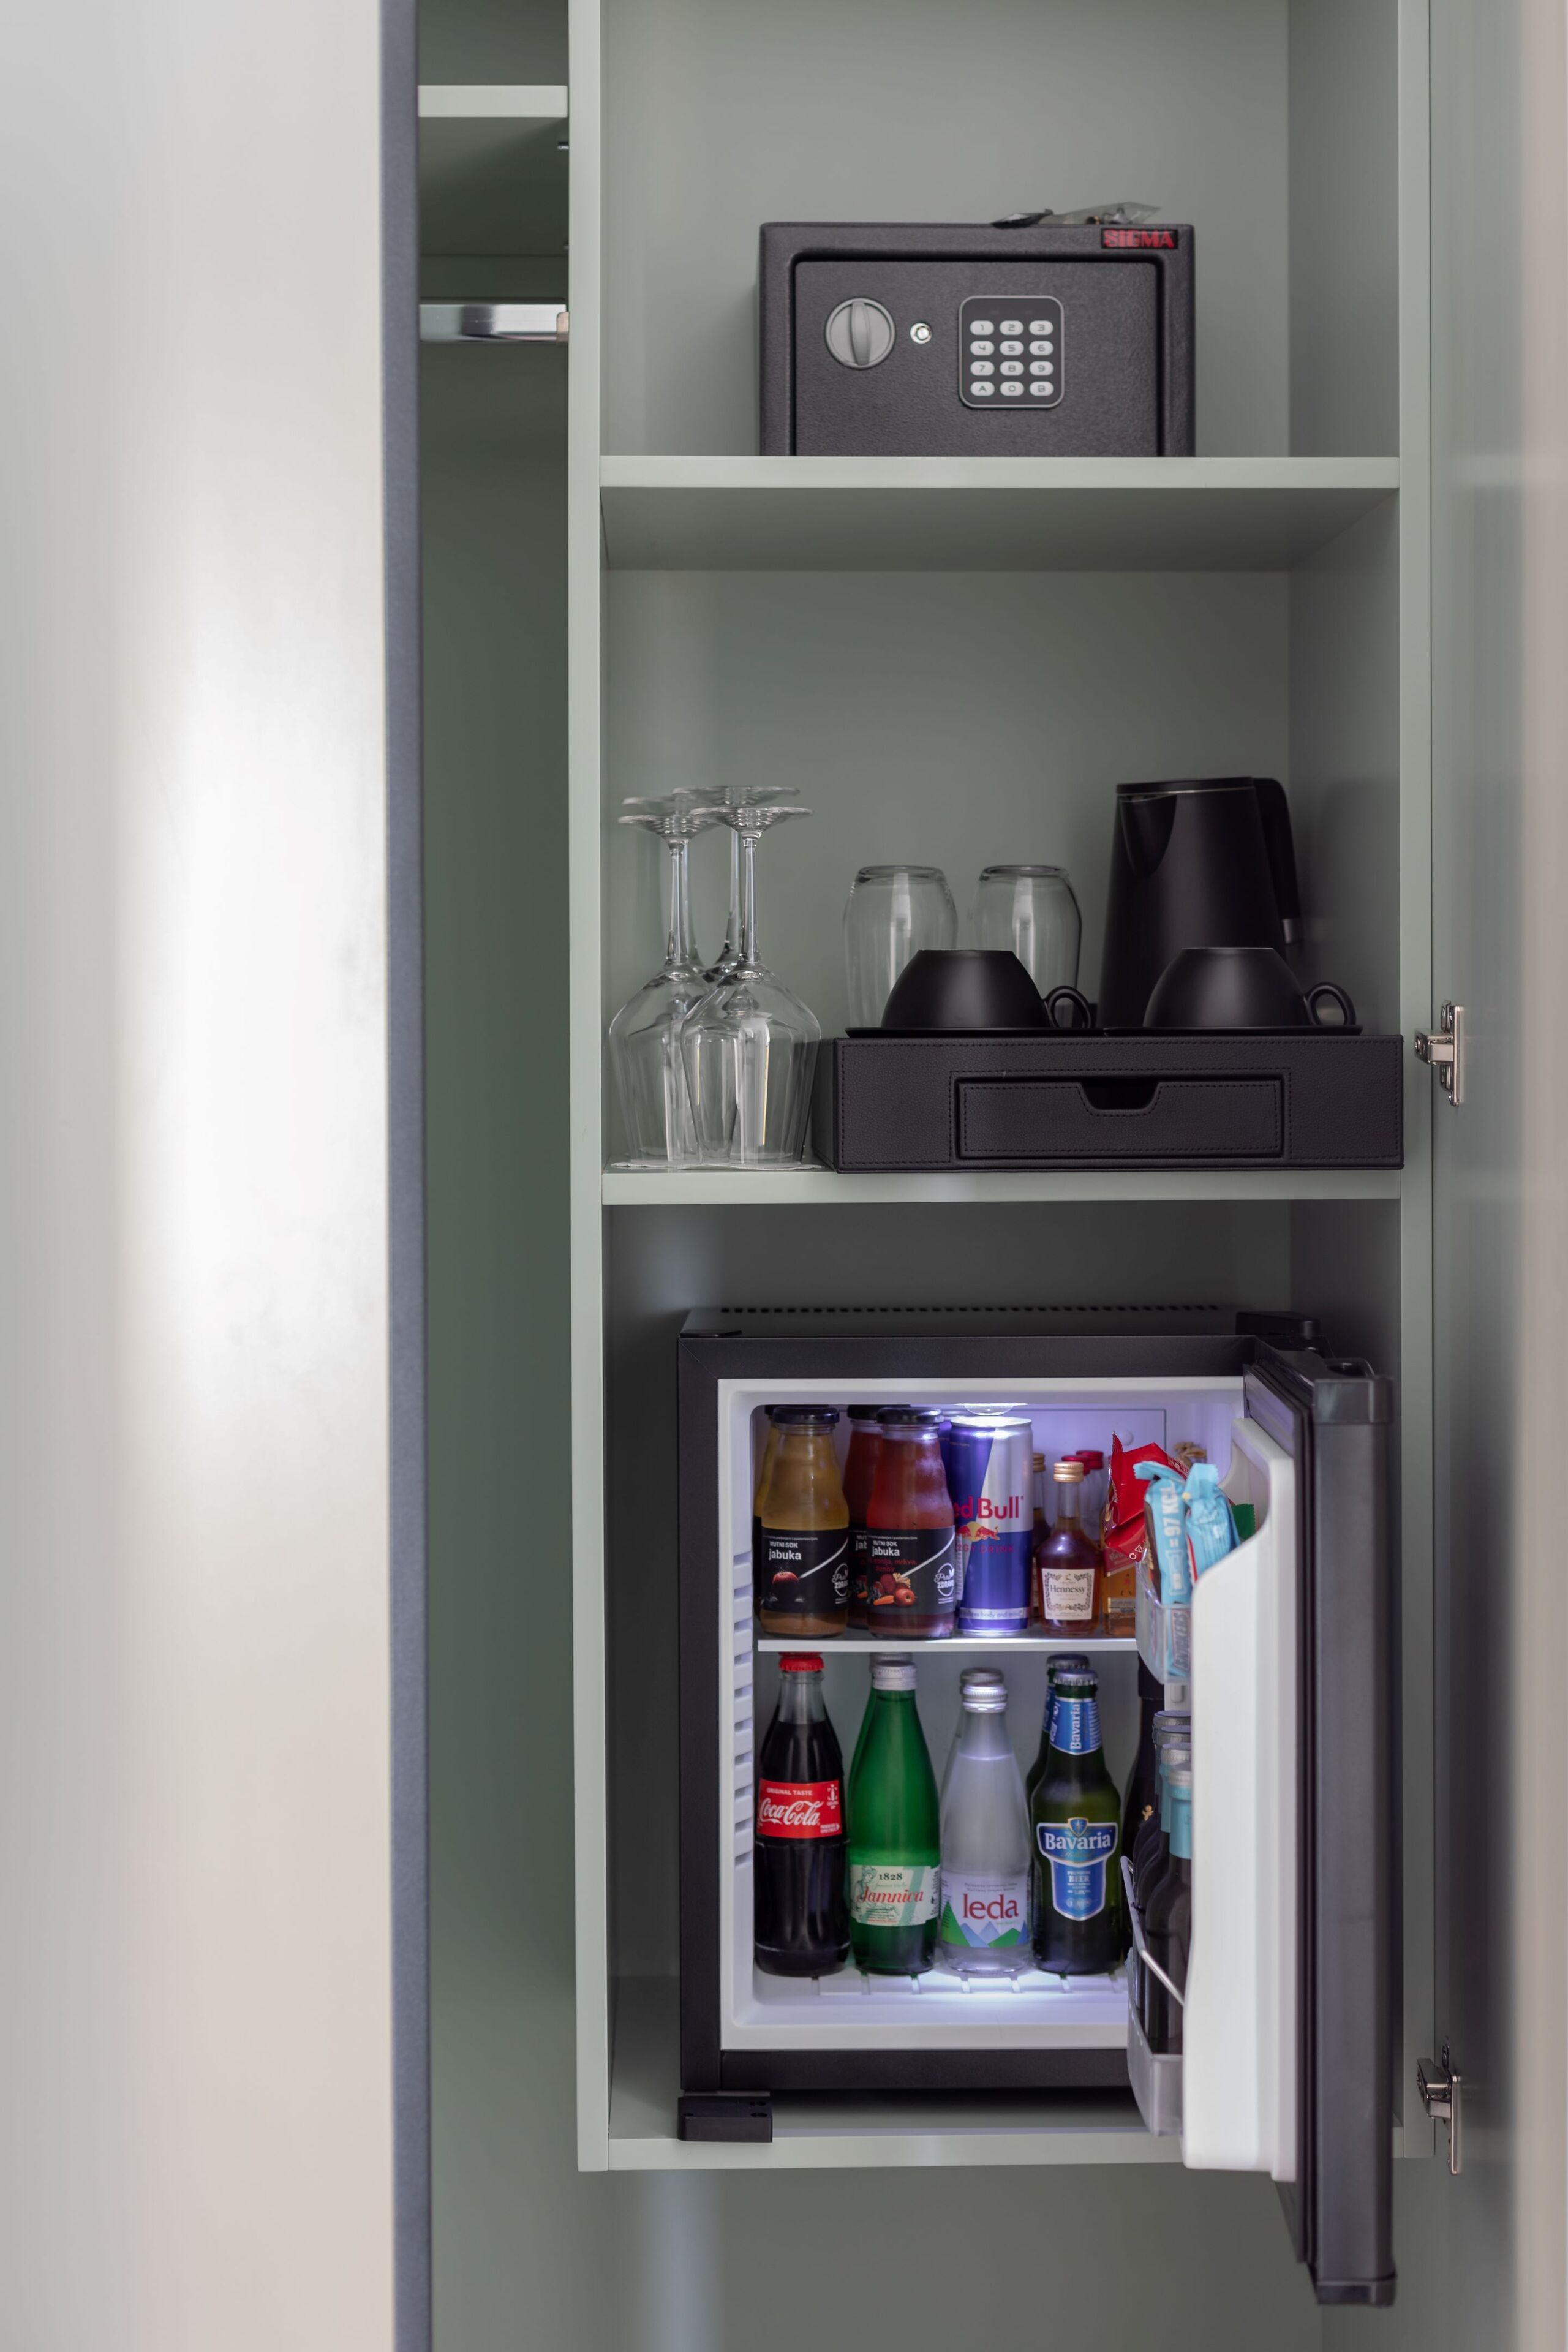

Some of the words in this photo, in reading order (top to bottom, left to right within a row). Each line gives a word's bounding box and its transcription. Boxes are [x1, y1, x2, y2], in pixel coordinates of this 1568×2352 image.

[1104, 229, 1174, 249] SIGMA
[954, 1496, 973, 1518] ed
[978, 1496, 1019, 1519] Bull
[1163, 1518, 1182, 1537] 97
[768, 1549, 802, 1561] jabuka
[872, 1547, 900, 1557] jabuka
[980, 1545, 1014, 1554] DRINK
[1050, 1585, 1085, 1594] Hennessy
[1070, 1704, 1081, 1749] Bavaria
[760, 1798, 824, 1825] Coca-Cola
[1045, 1832, 1111, 1850] Bavaria
[858, 1886, 924, 1903] Jamnica
[963, 1893, 1019, 1919] leda
